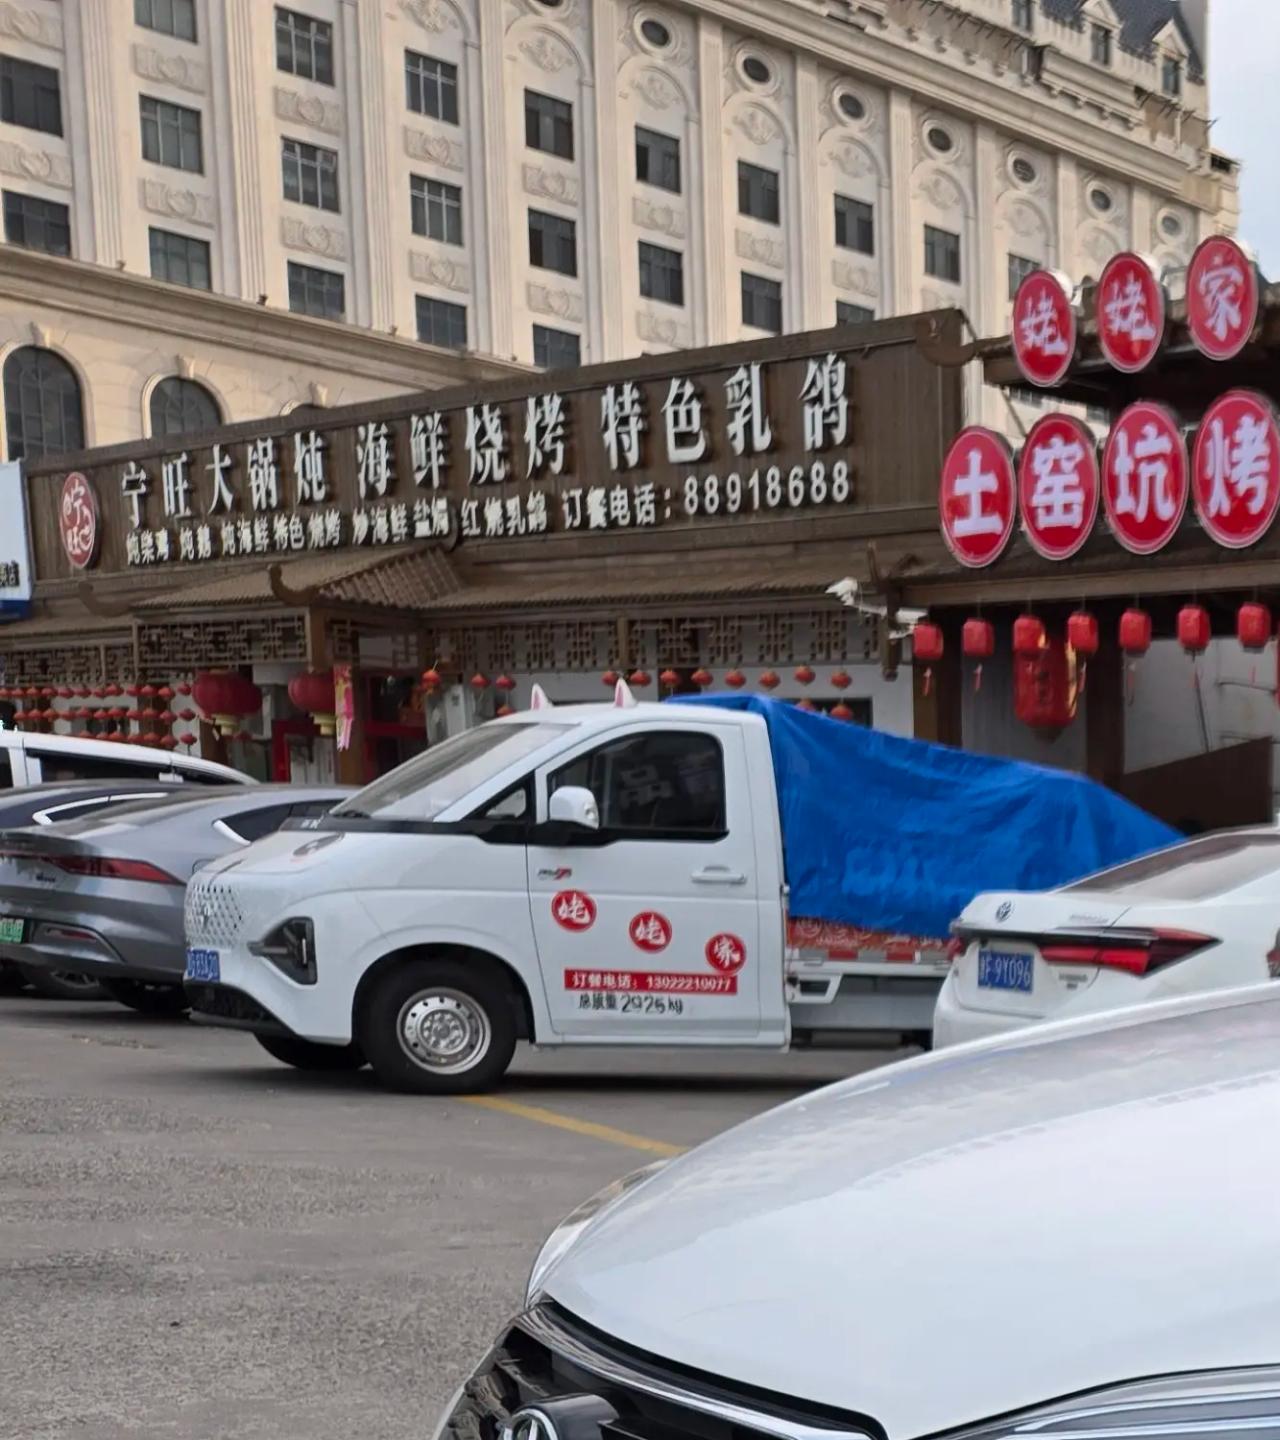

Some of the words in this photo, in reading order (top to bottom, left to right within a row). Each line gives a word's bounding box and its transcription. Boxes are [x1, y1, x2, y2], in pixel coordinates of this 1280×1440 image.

[1020, 256, 1244, 355] 姥姥家
[122, 429, 327, 528] 宁旺大锅炖
[356, 392, 565, 499] 海鲜烧烤
[601, 352, 849, 470] 特色乳鸽
[952, 411, 1275, 536] 土窑坑烤
